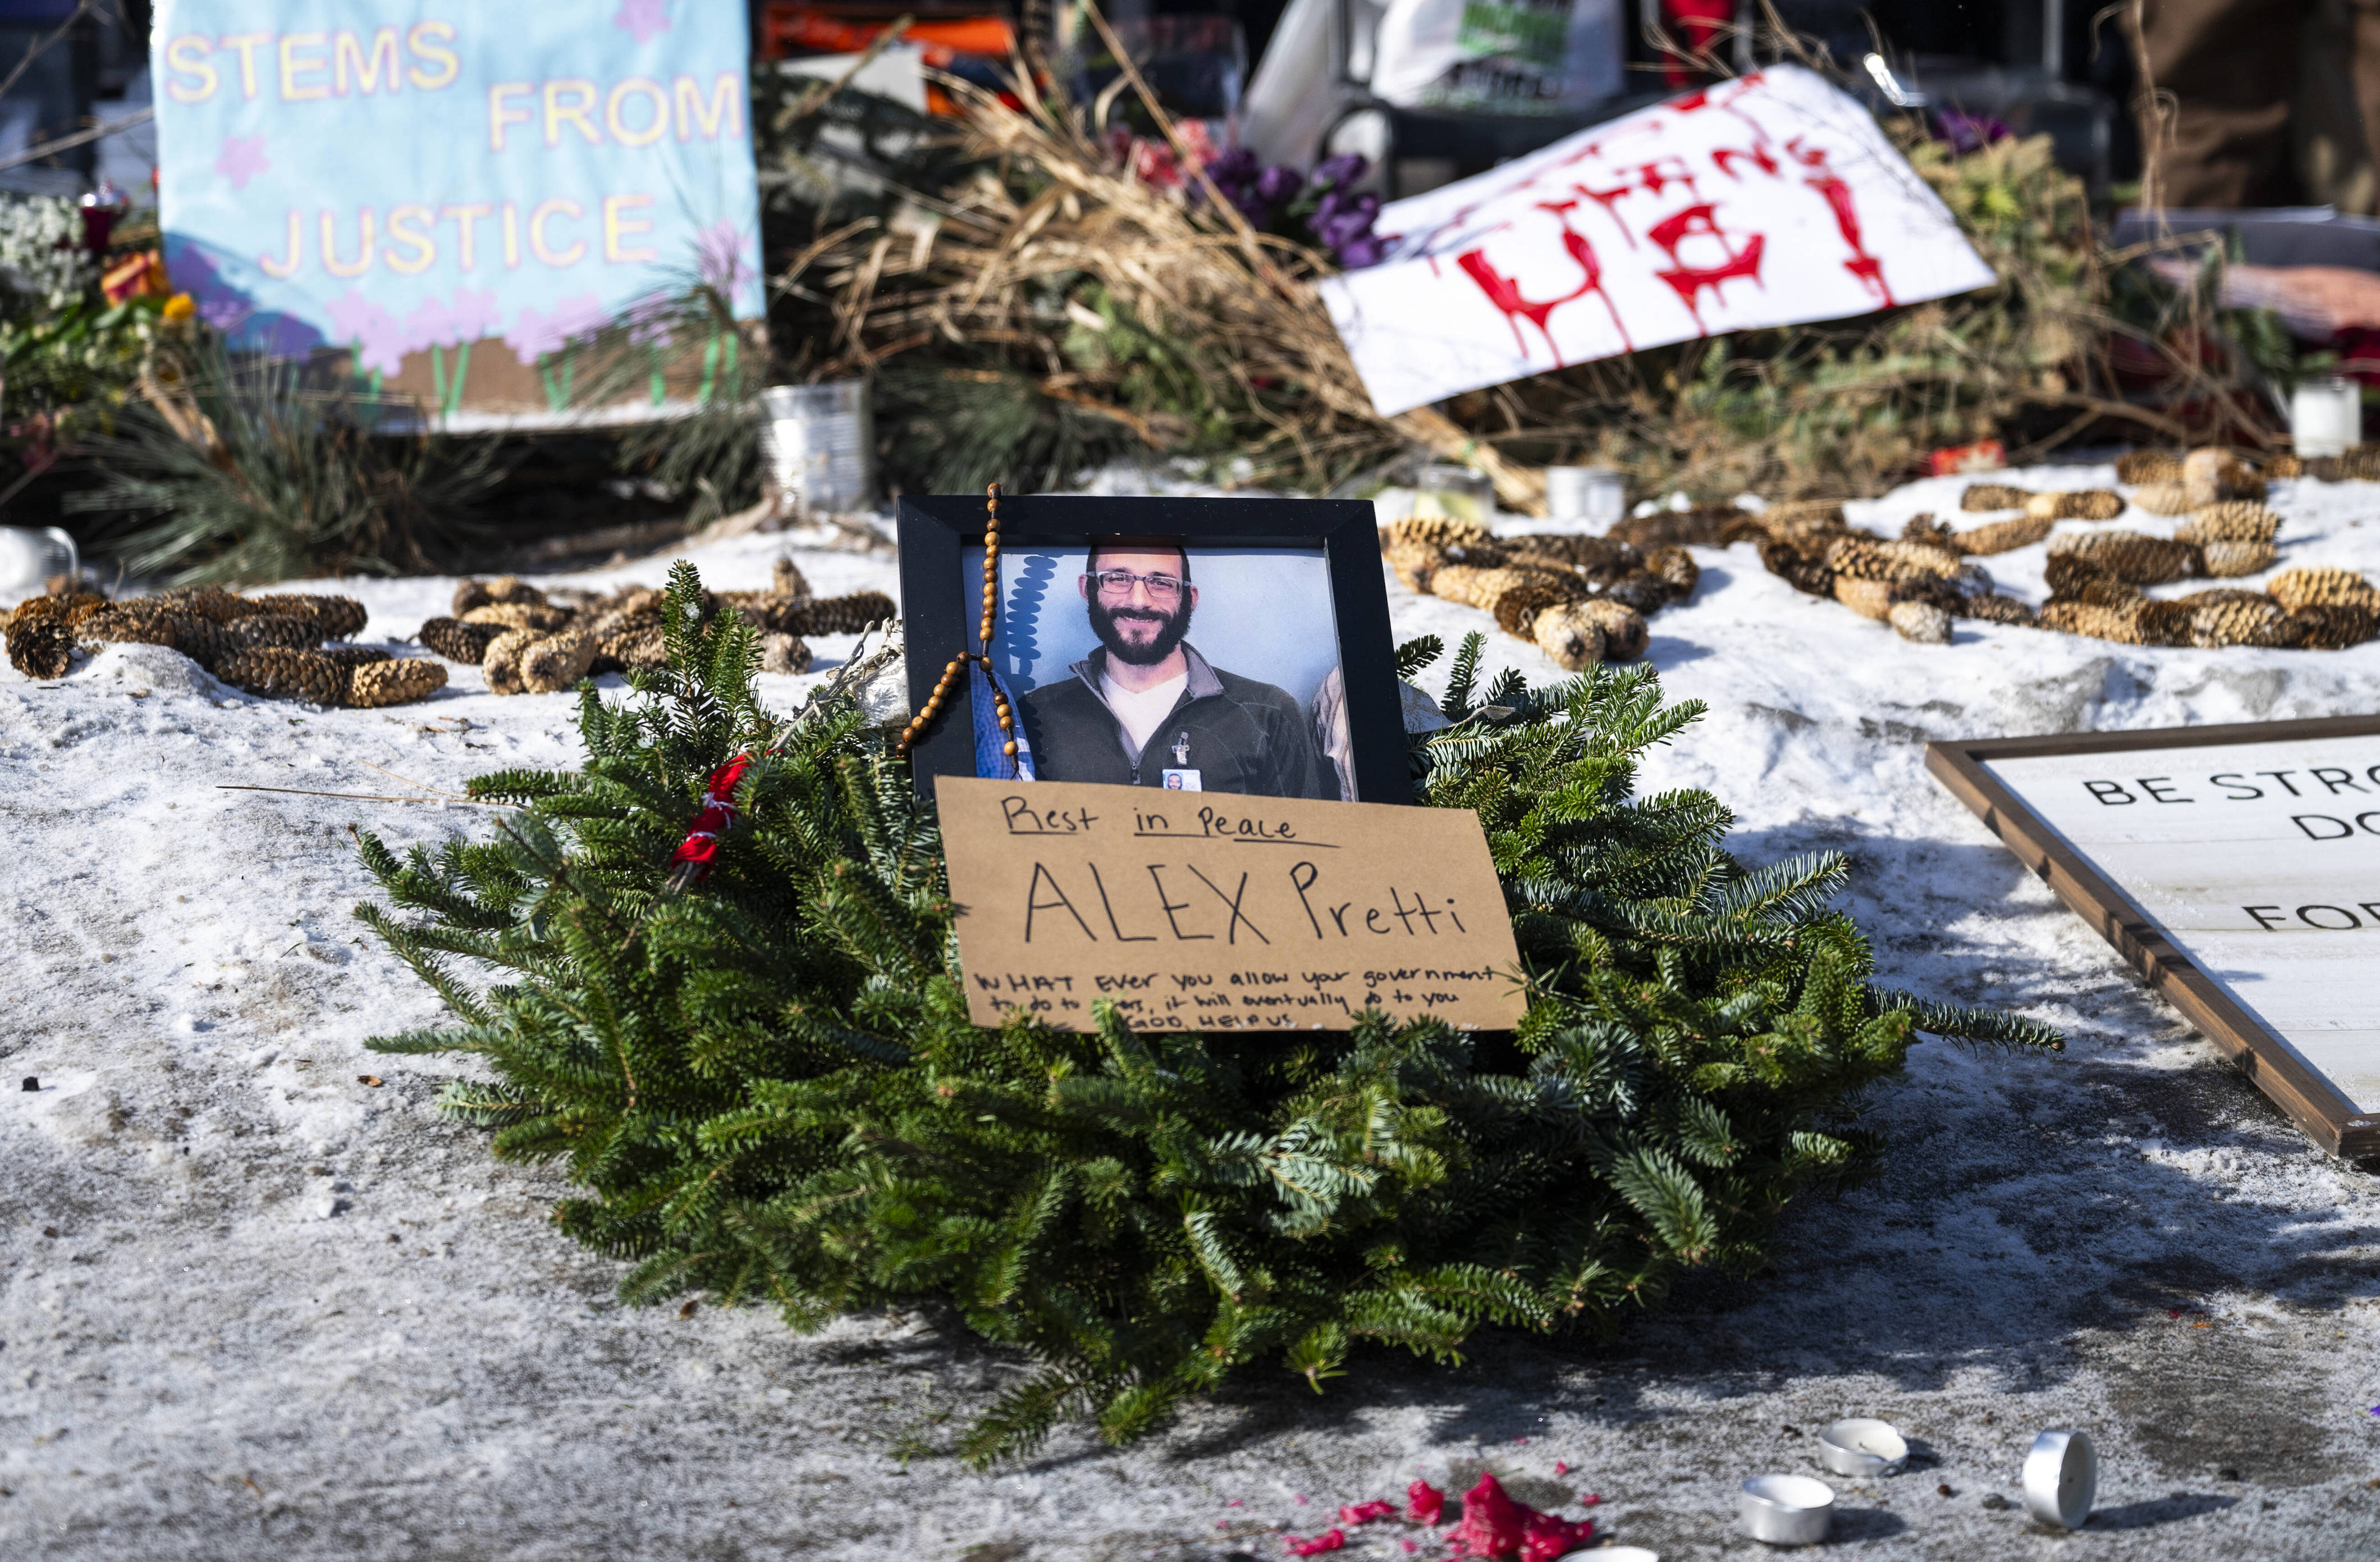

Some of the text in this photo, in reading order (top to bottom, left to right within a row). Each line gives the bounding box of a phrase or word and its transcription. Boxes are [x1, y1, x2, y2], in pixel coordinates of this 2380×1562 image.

[166, 20, 459, 105] STEMS
[488, 73, 745, 152] FROM
[257, 194, 659, 280] JUSTICE
[2082, 765, 2380, 806] BE STR
[1001, 796, 1297, 839] Rest in Peace
[1026, 861, 1466, 946] ALEX Pretti
[973, 972, 1073, 993] WHAT
[1170, 973, 1213, 992] you
[1230, 971, 1289, 986] allow
[1301, 971, 1349, 991] your
[1363, 966, 1494, 988] government
[1029, 993, 1052, 1012] do
[1061, 997, 1080, 1010] to
[1163, 994, 1188, 1011] it
[1193, 991, 1232, 1008] will
[1242, 992, 1350, 1015] eventually
[1364, 991, 1381, 1006] do
[1393, 988, 1413, 1003] to
[1421, 992, 1460, 1008] you
[1125, 1015, 1182, 1029] GOD
